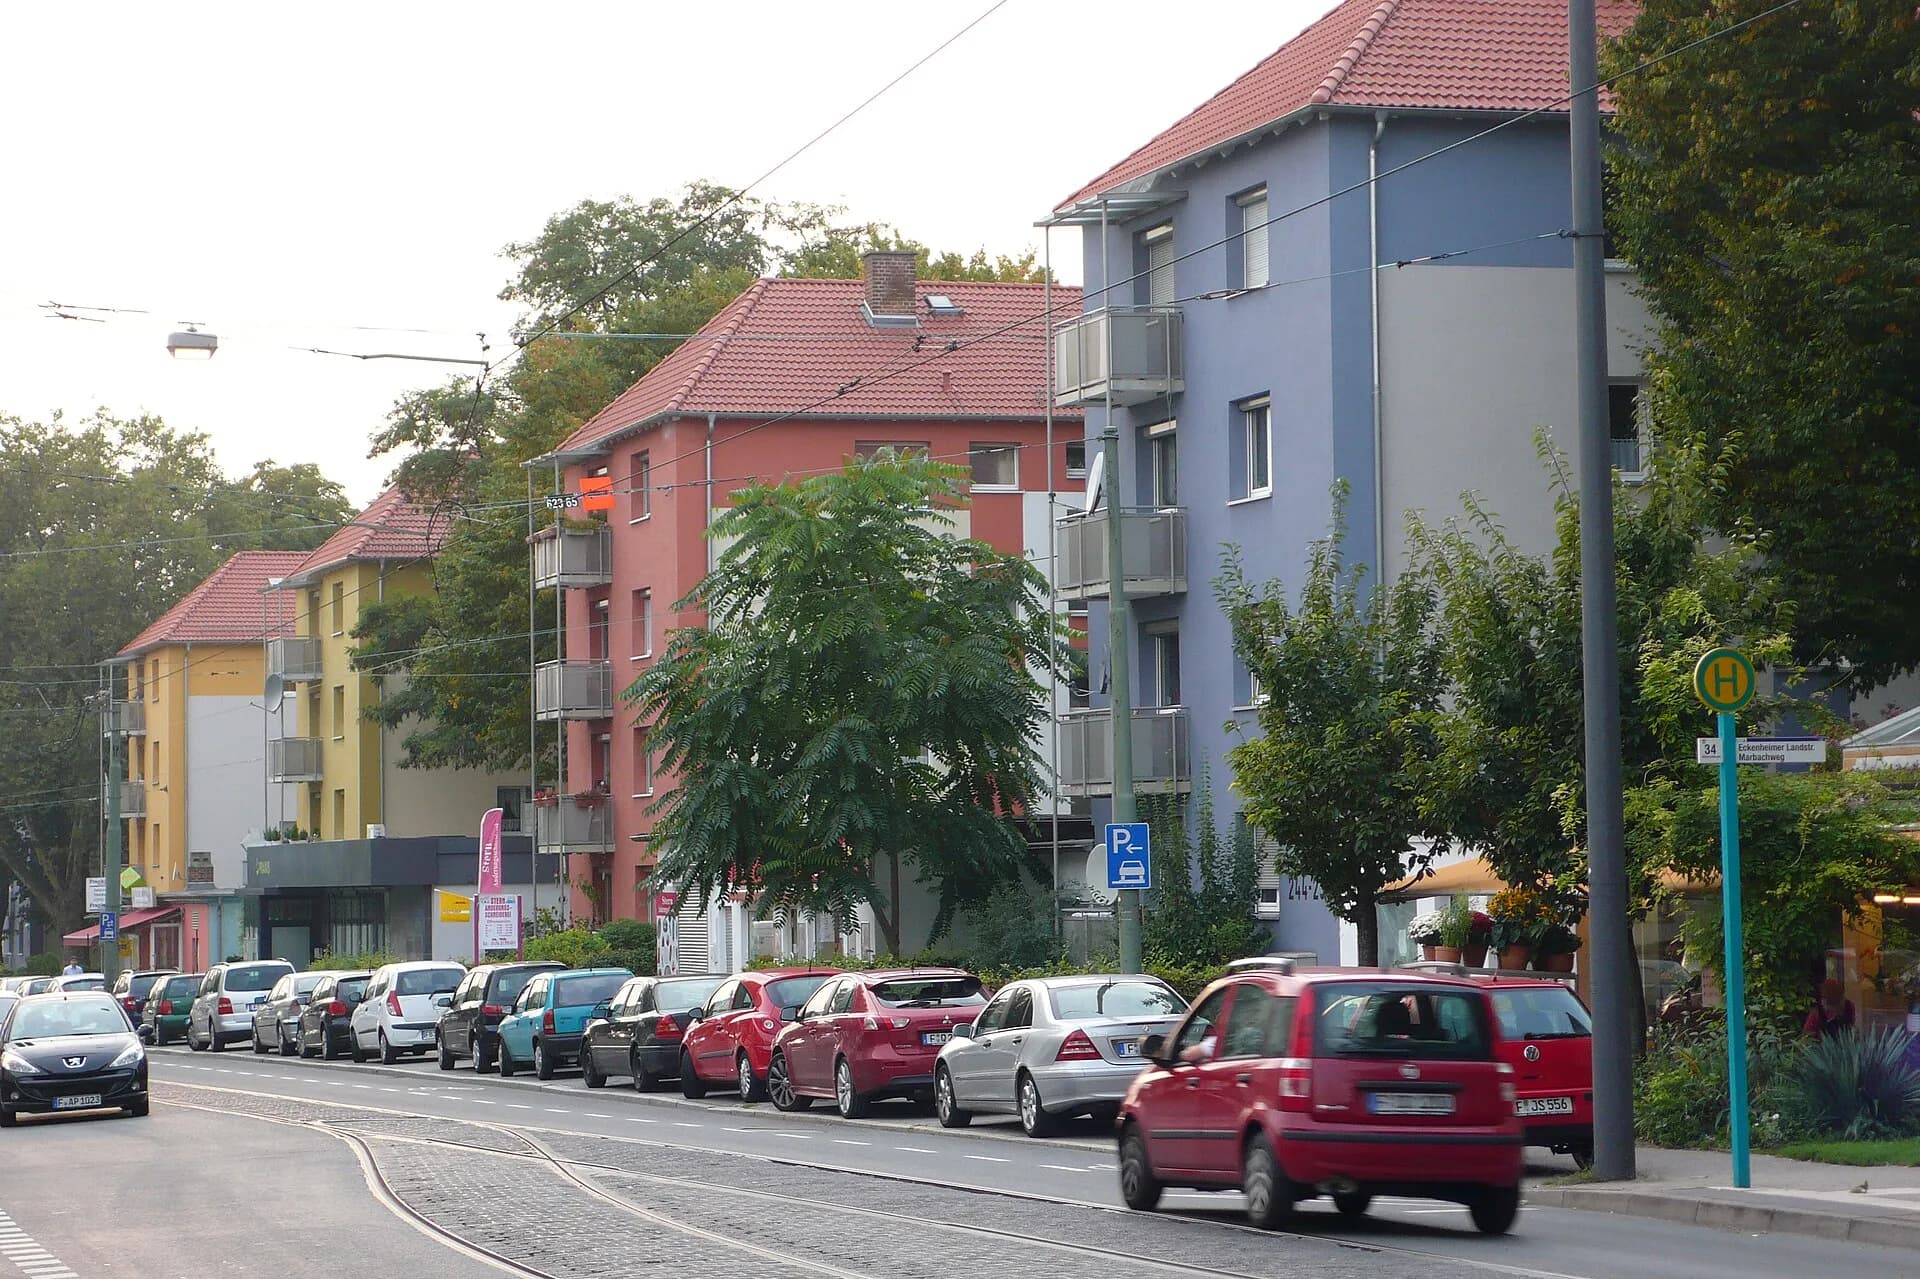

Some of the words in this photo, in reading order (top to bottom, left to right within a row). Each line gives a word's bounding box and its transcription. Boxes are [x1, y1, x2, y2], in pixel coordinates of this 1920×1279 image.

[1714, 663, 1738, 697] H
[1704, 744, 1717, 755] 34
[1738, 743, 1784, 752] Eckenheimer
[1786, 743, 1816, 752] Landstr.
[1738, 753, 1785, 762] Marbachweg
[1112, 828, 1131, 854] P
[482, 842, 492, 873] Stern
[102, 914, 110, 926] P
[1127, 1043, 1134, 1054] F
[1515, 1101, 1523, 1112] F
[1530, 1100, 1546, 1111] JS
[1546, 1098, 1568, 1110] 556
